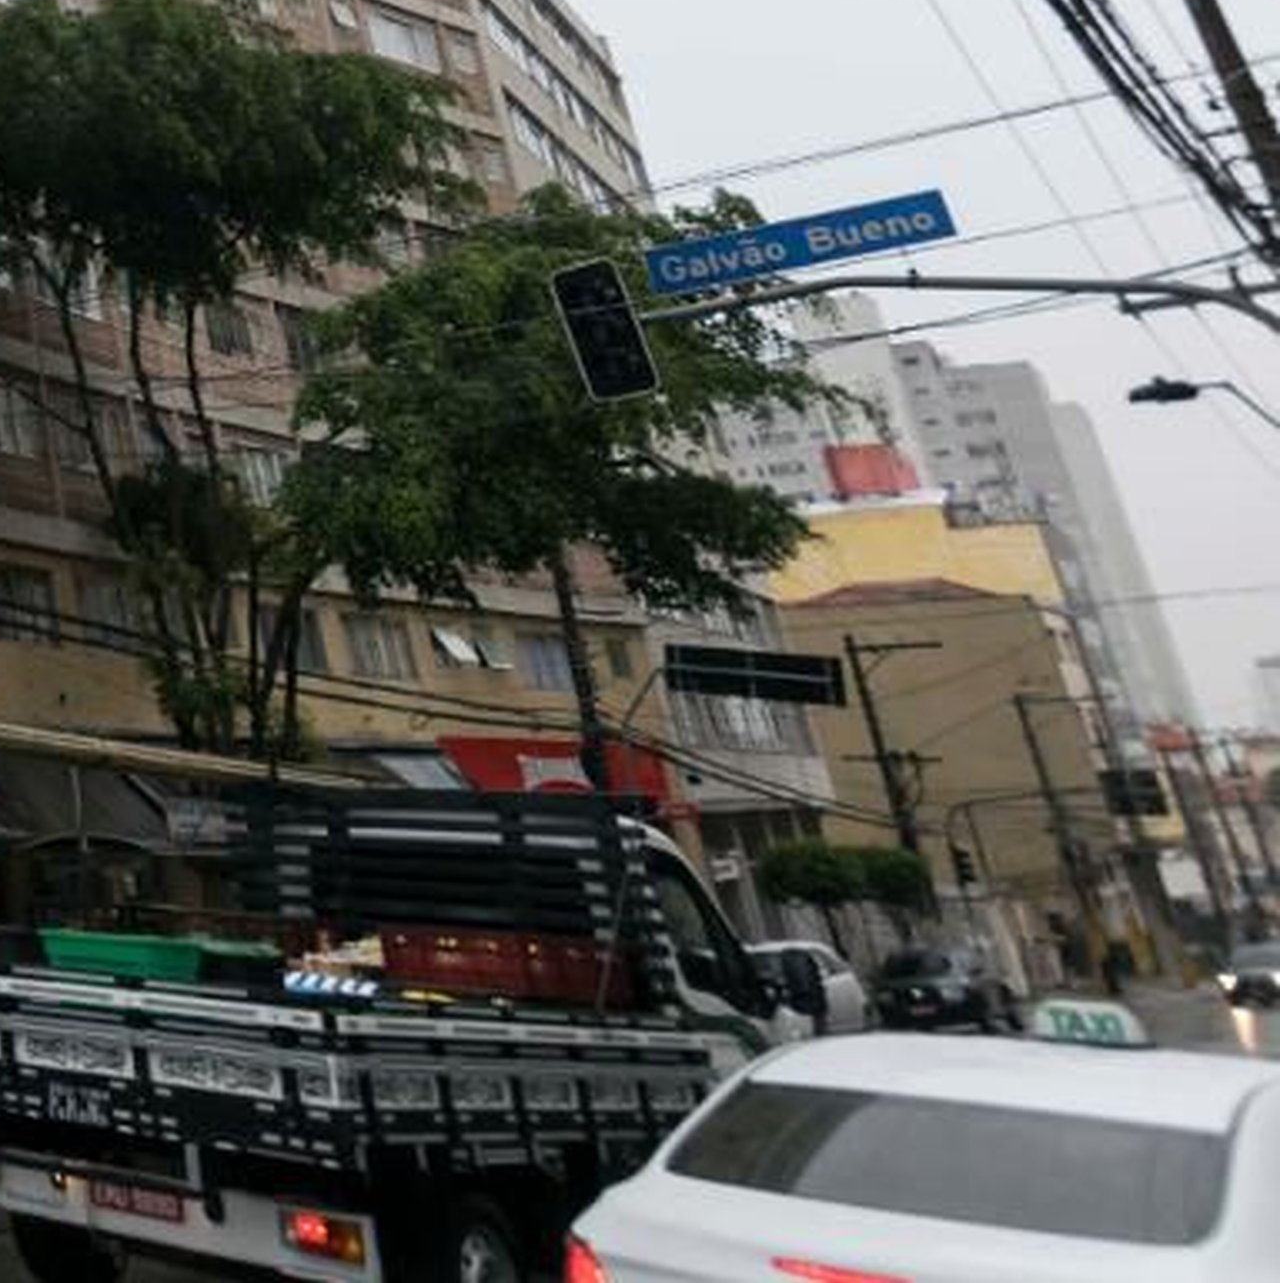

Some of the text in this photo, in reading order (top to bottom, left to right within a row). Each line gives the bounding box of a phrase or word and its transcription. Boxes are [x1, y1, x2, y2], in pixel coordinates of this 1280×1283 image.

[659, 211, 936, 283] Galvão Bueno
[1049, 1008, 1127, 1044] TAXI
